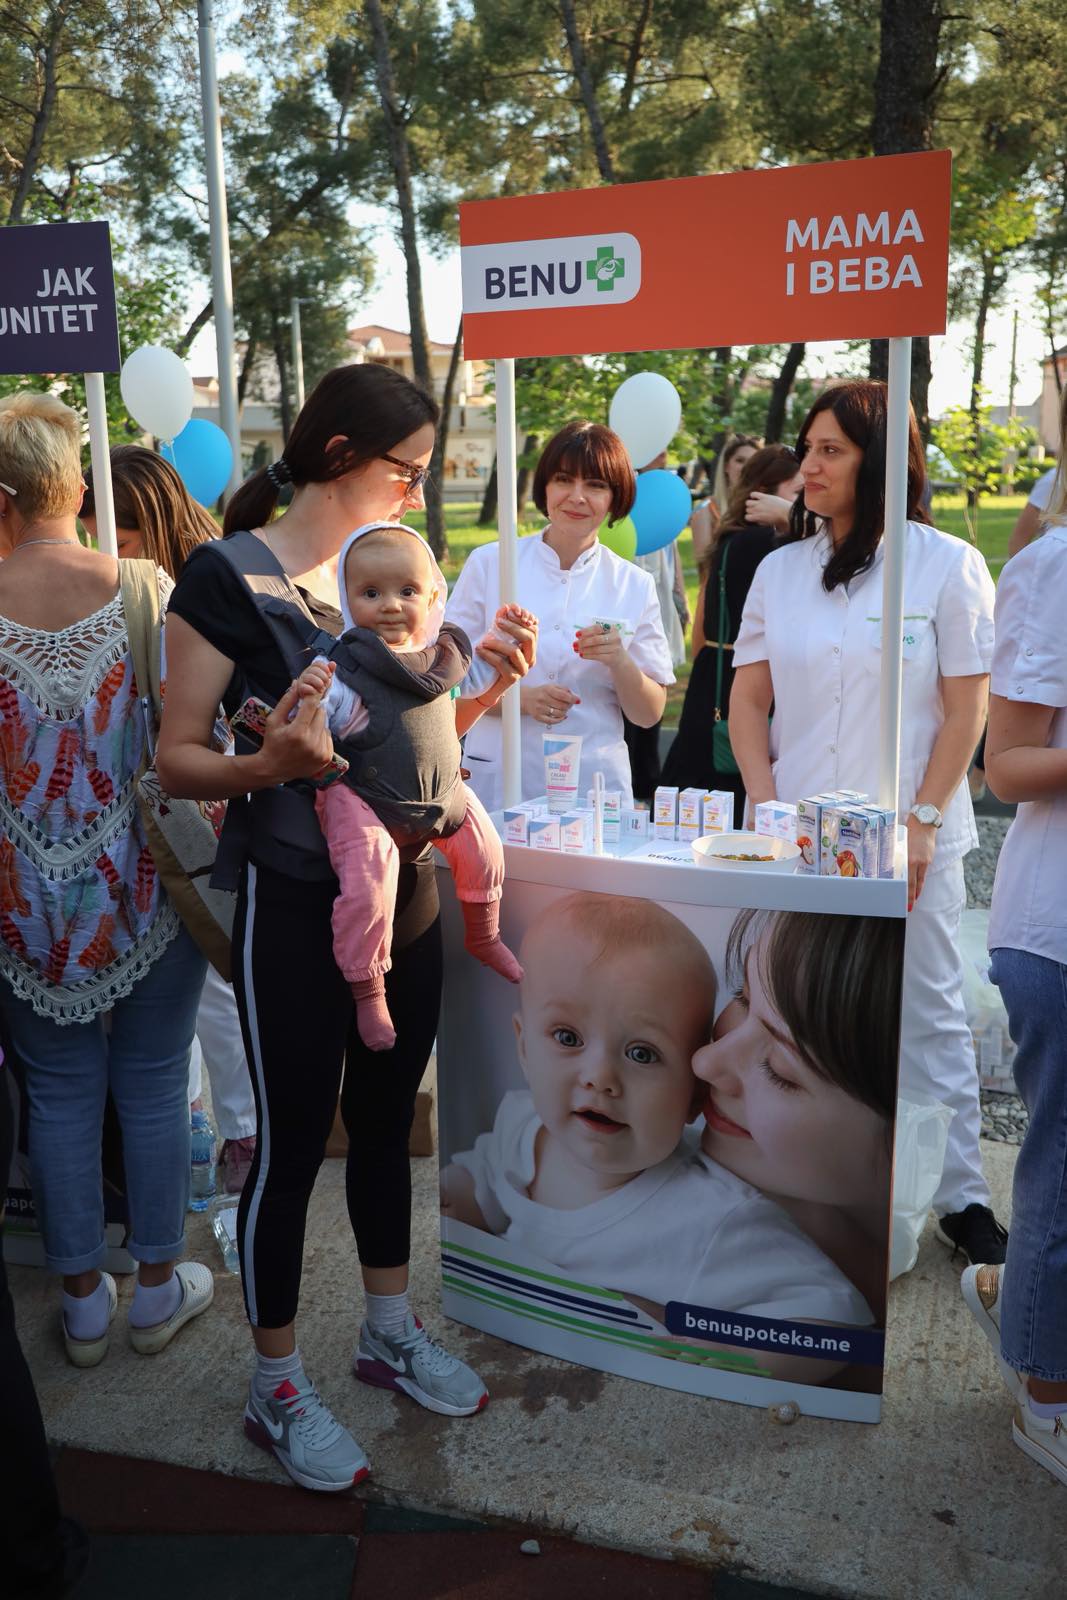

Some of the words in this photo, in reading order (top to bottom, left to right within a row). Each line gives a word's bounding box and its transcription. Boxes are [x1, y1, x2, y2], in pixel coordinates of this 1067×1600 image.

[785, 209, 924, 253] MAMA
[36, 266, 97, 298] JAK
[484, 261, 582, 300] BENU
[786, 263, 794, 296] I
[810, 254, 923, 294] BEBA
[685, 1311, 851, 1352] benuapoteka.me
